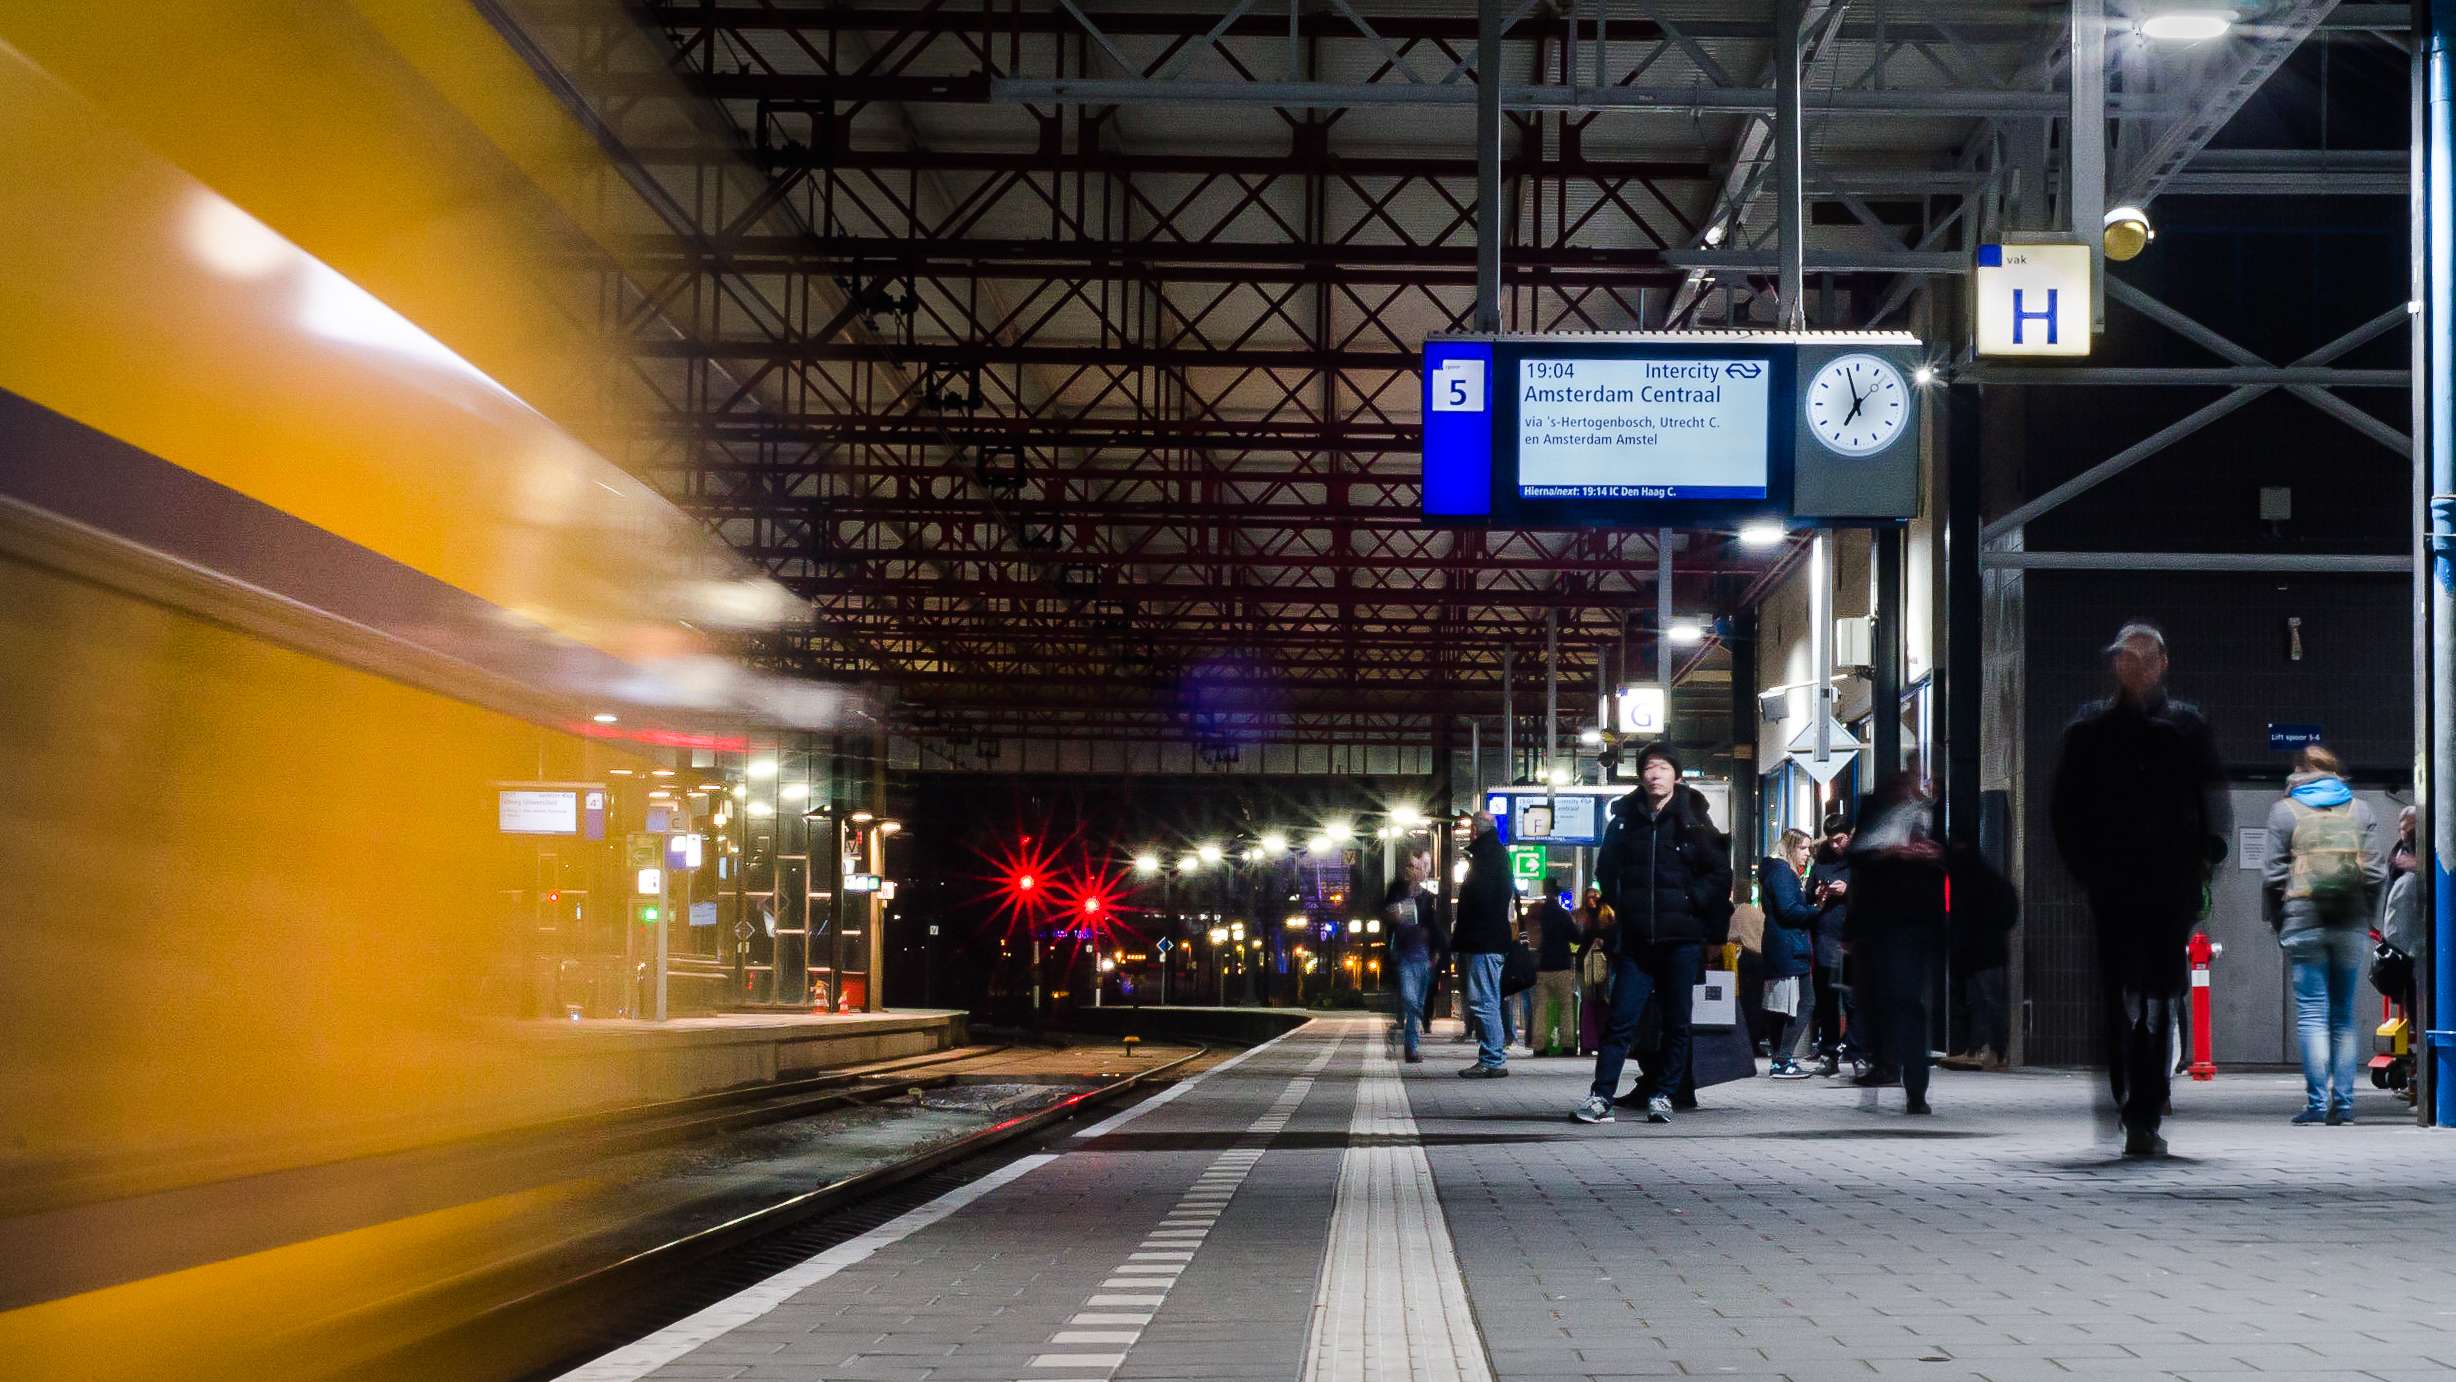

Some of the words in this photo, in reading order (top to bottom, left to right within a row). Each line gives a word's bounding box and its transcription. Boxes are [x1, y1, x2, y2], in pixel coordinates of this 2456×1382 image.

[2006, 255, 2027, 264] vak
[2012, 288, 2058, 345] H
[1527, 362, 1575, 379] 19:04
[1645, 362, 1720, 383] Intercity
[1450, 379, 1467, 406] 5
[1524, 384, 1634, 402] Amsterdam
[1641, 384, 1721, 403] Centraal
[1525, 415, 1543, 428] via
[1547, 415, 1656, 431] 's-Hertogenbosch,
[1660, 416, 1705, 428] Utrecht
[1709, 416, 1721, 429] C.
[1525, 435, 1539, 445] en
[1543, 434, 1612, 445] Amsterdam
[1616, 433, 1658, 445] Amstel
[1524, 486, 1580, 497] Hierna/next:
[1582, 486, 1607, 497] 19:14
[1609, 486, 1619, 497] IC
[1621, 486, 1640, 497] Den
[1641, 486, 1665, 498] Haag
[1667, 486, 1677, 497] C.
[1631, 702, 1652, 728] G
[1533, 819, 1544, 834] F
